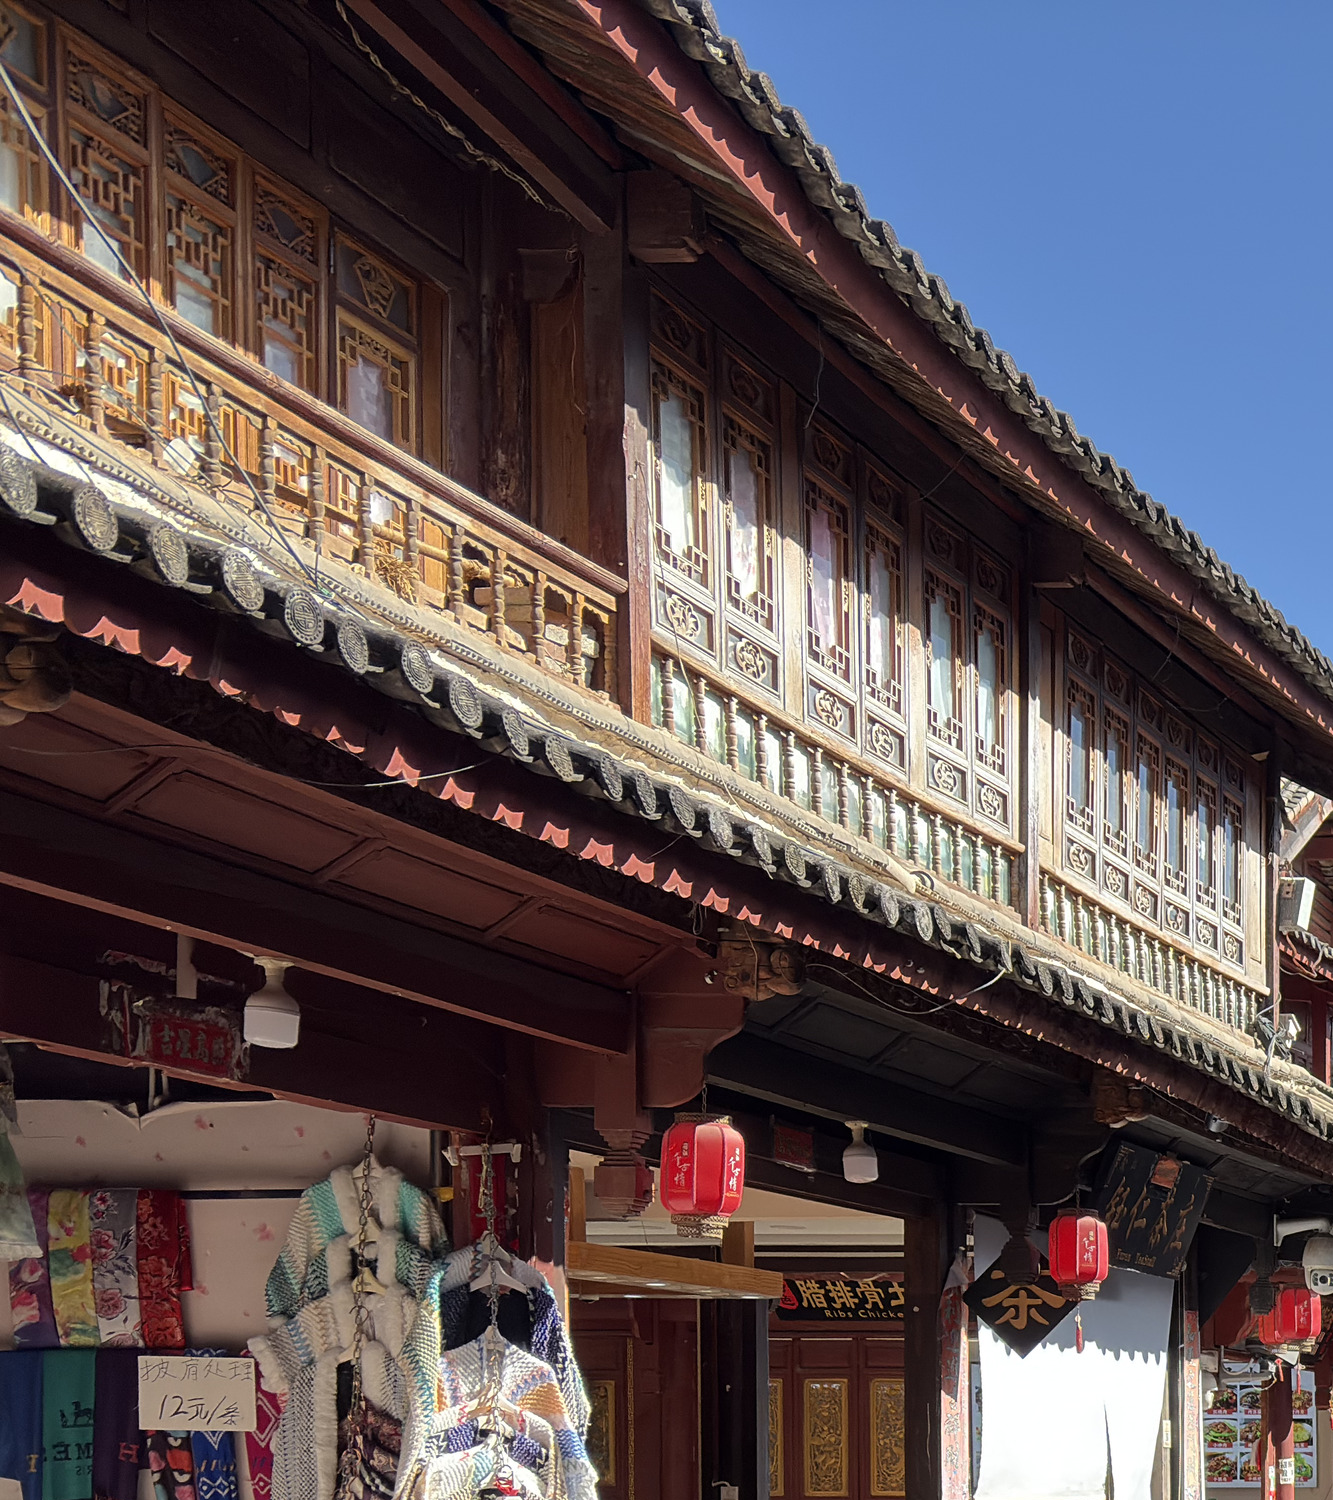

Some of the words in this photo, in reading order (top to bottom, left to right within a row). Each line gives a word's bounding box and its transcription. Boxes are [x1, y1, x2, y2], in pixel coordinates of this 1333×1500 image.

[981, 1269, 1067, 1330] 茶
[824, 1309, 853, 1319] Ribs
[140, 1359, 254, 1383] 披肩处理
[159, 1394, 244, 1427] 12元/条
